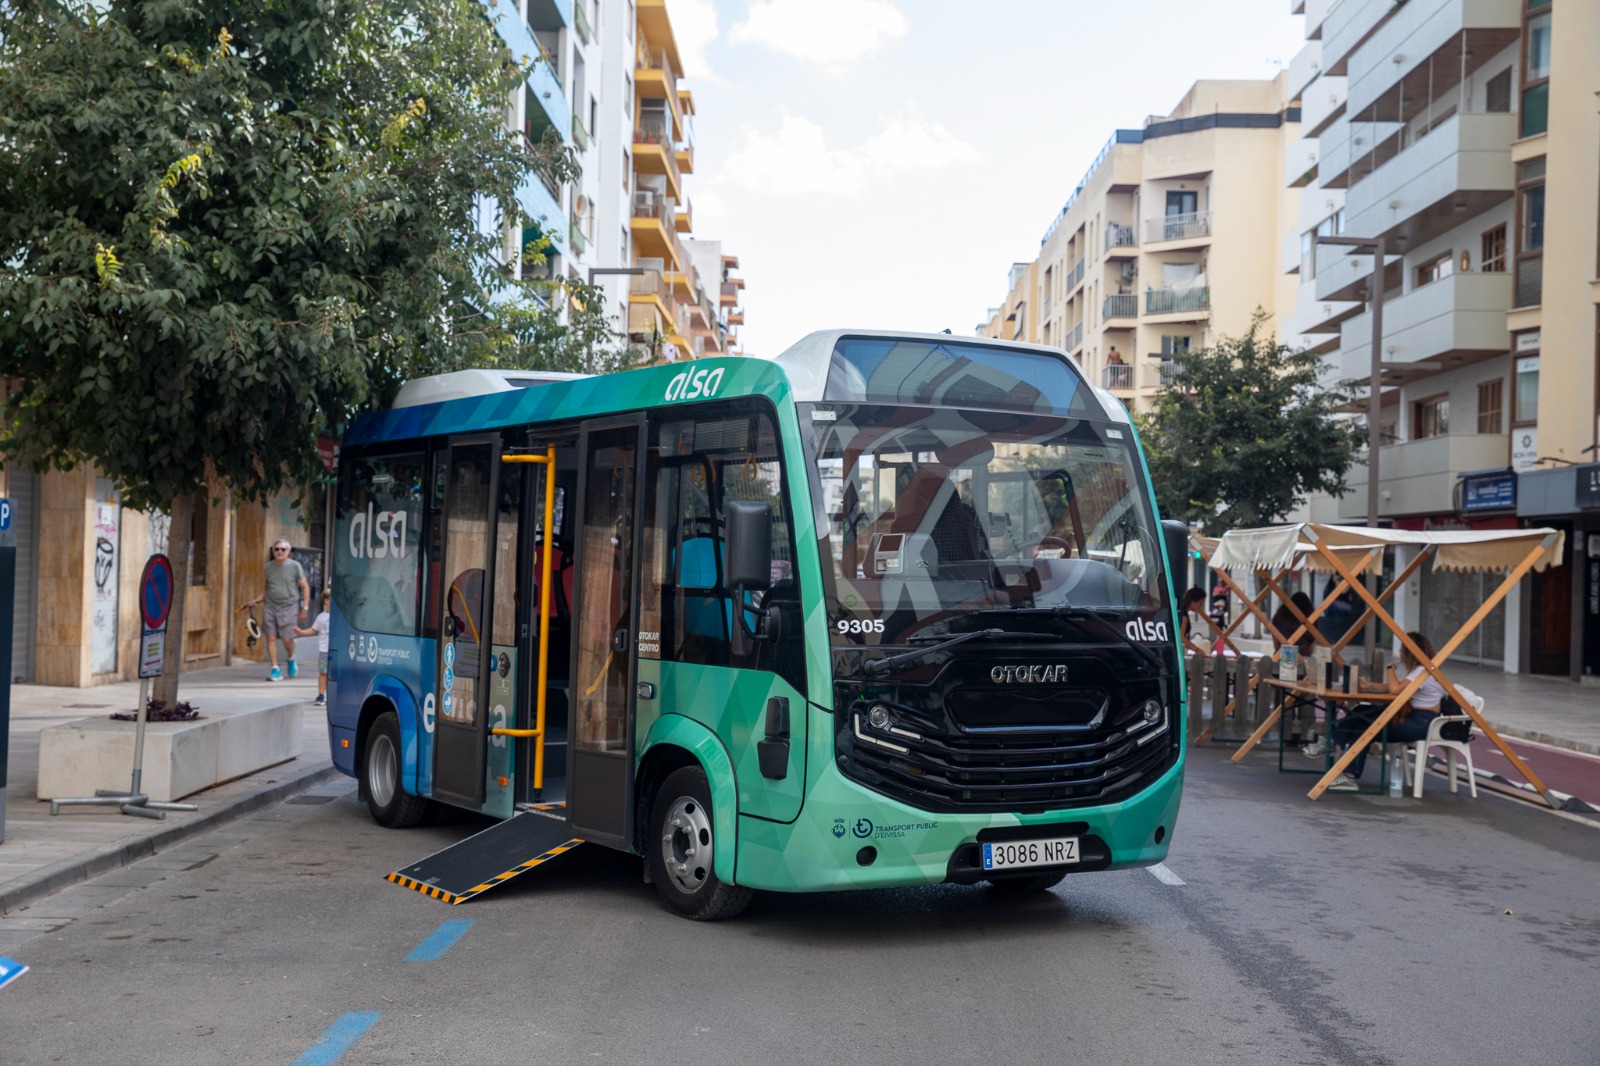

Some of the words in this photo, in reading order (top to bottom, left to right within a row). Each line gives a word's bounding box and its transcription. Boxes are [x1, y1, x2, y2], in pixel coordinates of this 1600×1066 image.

[664, 364, 726, 401] alsa
[0, 502, 10, 527] P
[349, 500, 407, 559] alsa
[638, 631, 660, 641] OTOKAR
[837, 618, 886, 634] 9305
[1125, 616, 1169, 642] alsa
[638, 643, 659, 653] CENTRO
[990, 664, 1069, 684] OTOKAR
[874, 831, 906, 839] D'EIVISSA
[875, 823, 915, 832] TRANSPORT
[995, 844, 1038, 865] 3086
[1044, 841, 1075, 862] NRZ
